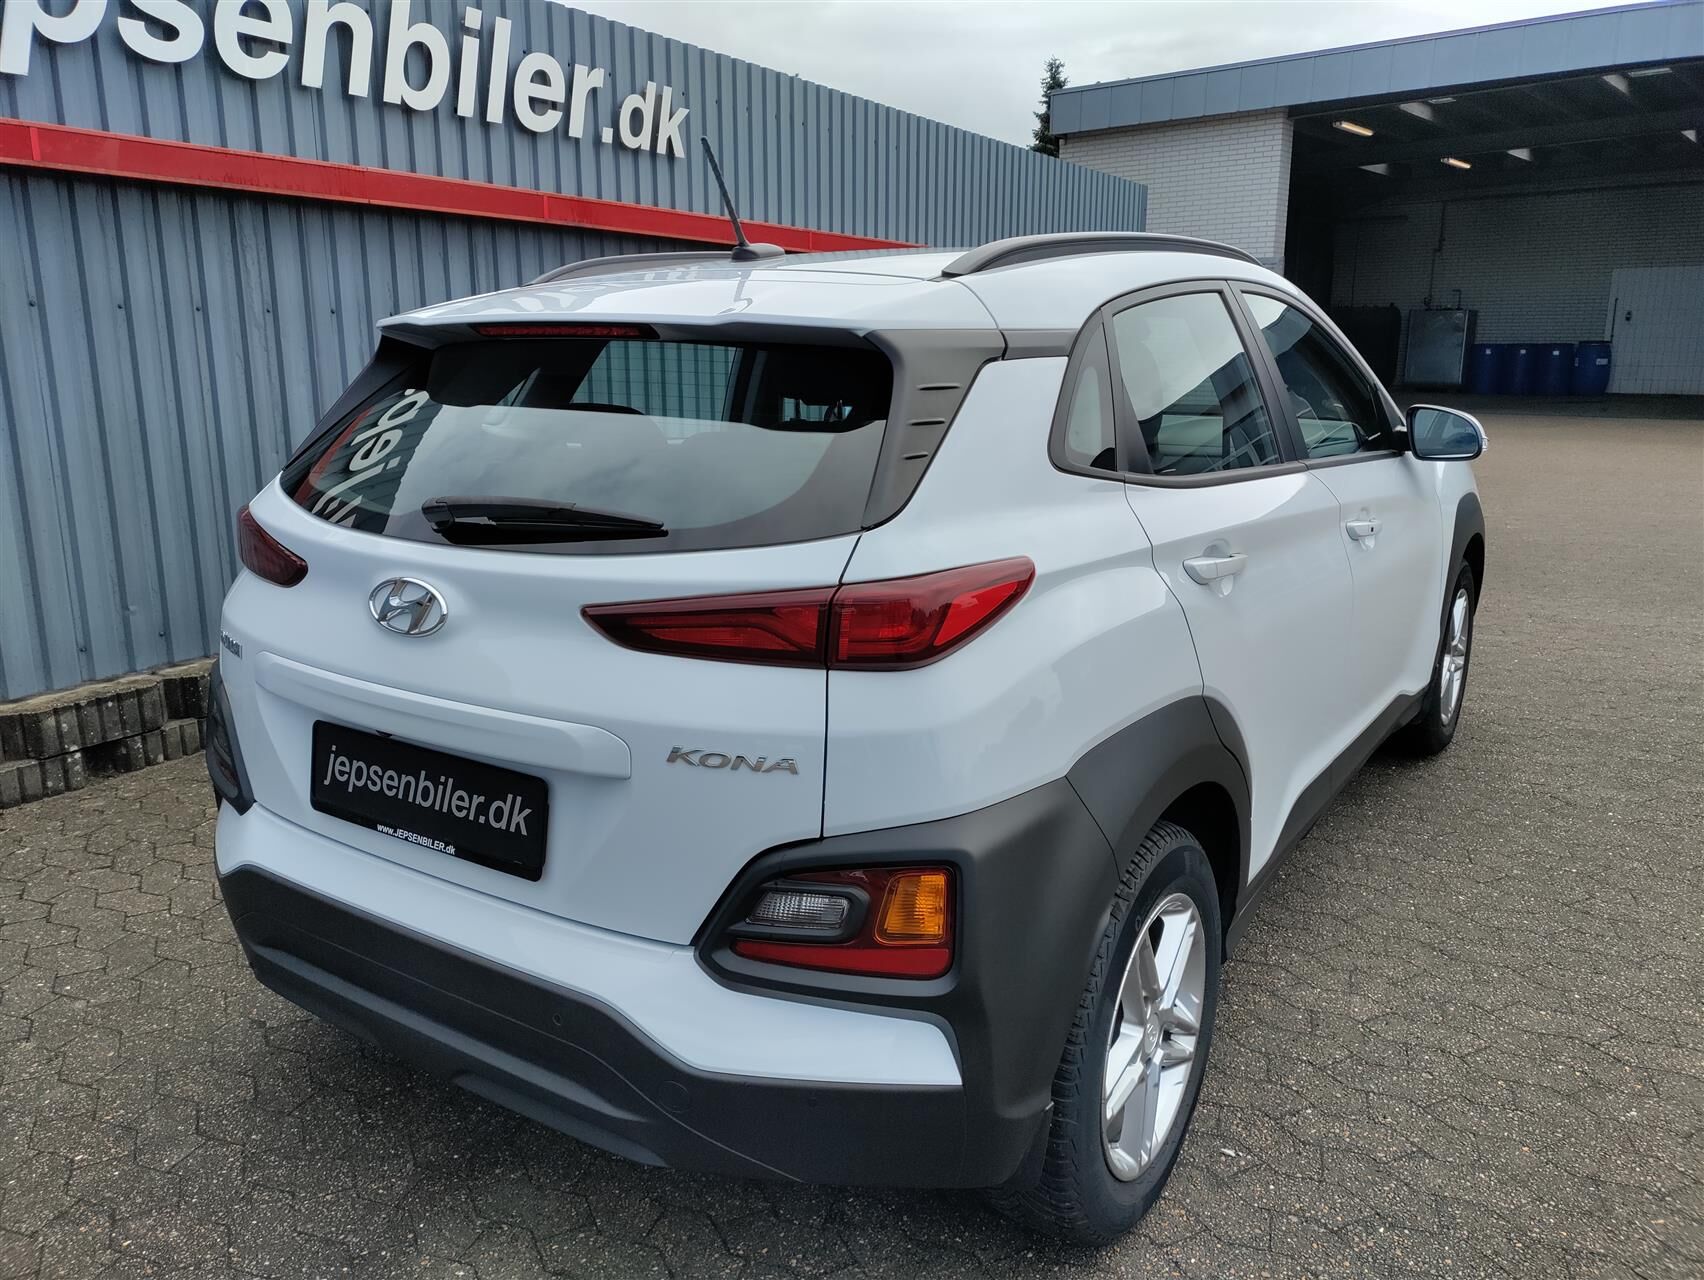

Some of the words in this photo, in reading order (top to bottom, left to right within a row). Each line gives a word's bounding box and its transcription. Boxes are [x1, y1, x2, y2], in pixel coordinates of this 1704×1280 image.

[666, 745, 799, 775] KONA
[323, 744, 533, 836] jepsenbiler.dk
[376, 823, 456, 855] www.JEPSENBILER.dk
